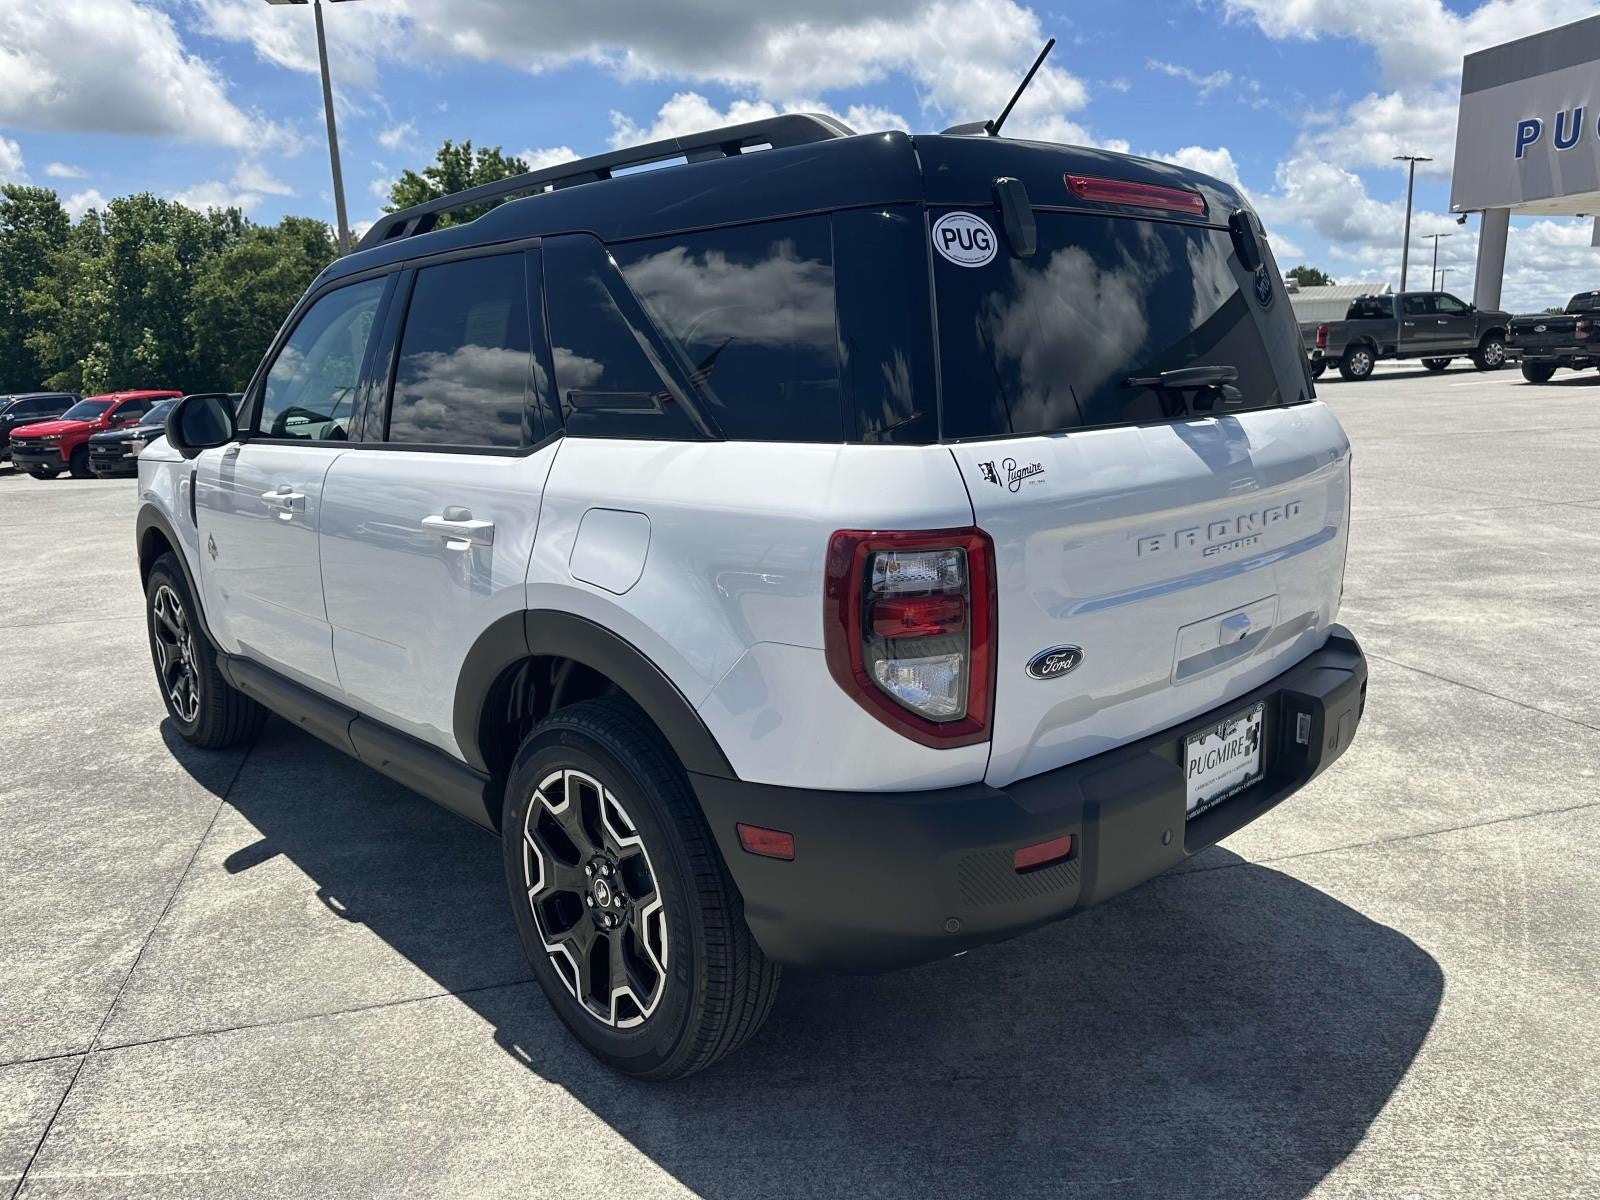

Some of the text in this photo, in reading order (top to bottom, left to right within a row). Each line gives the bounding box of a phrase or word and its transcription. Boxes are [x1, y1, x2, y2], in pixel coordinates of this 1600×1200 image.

[1514, 105, 1600, 160] PU
[941, 227, 991, 251] PUG
[1002, 457, 1045, 493] Pugmire
[1138, 500, 1303, 557] BRONCO
[1203, 532, 1263, 557] SPORT
[1042, 653, 1074, 674] Ford
[1188, 736, 1245, 779] PUGMIRE
